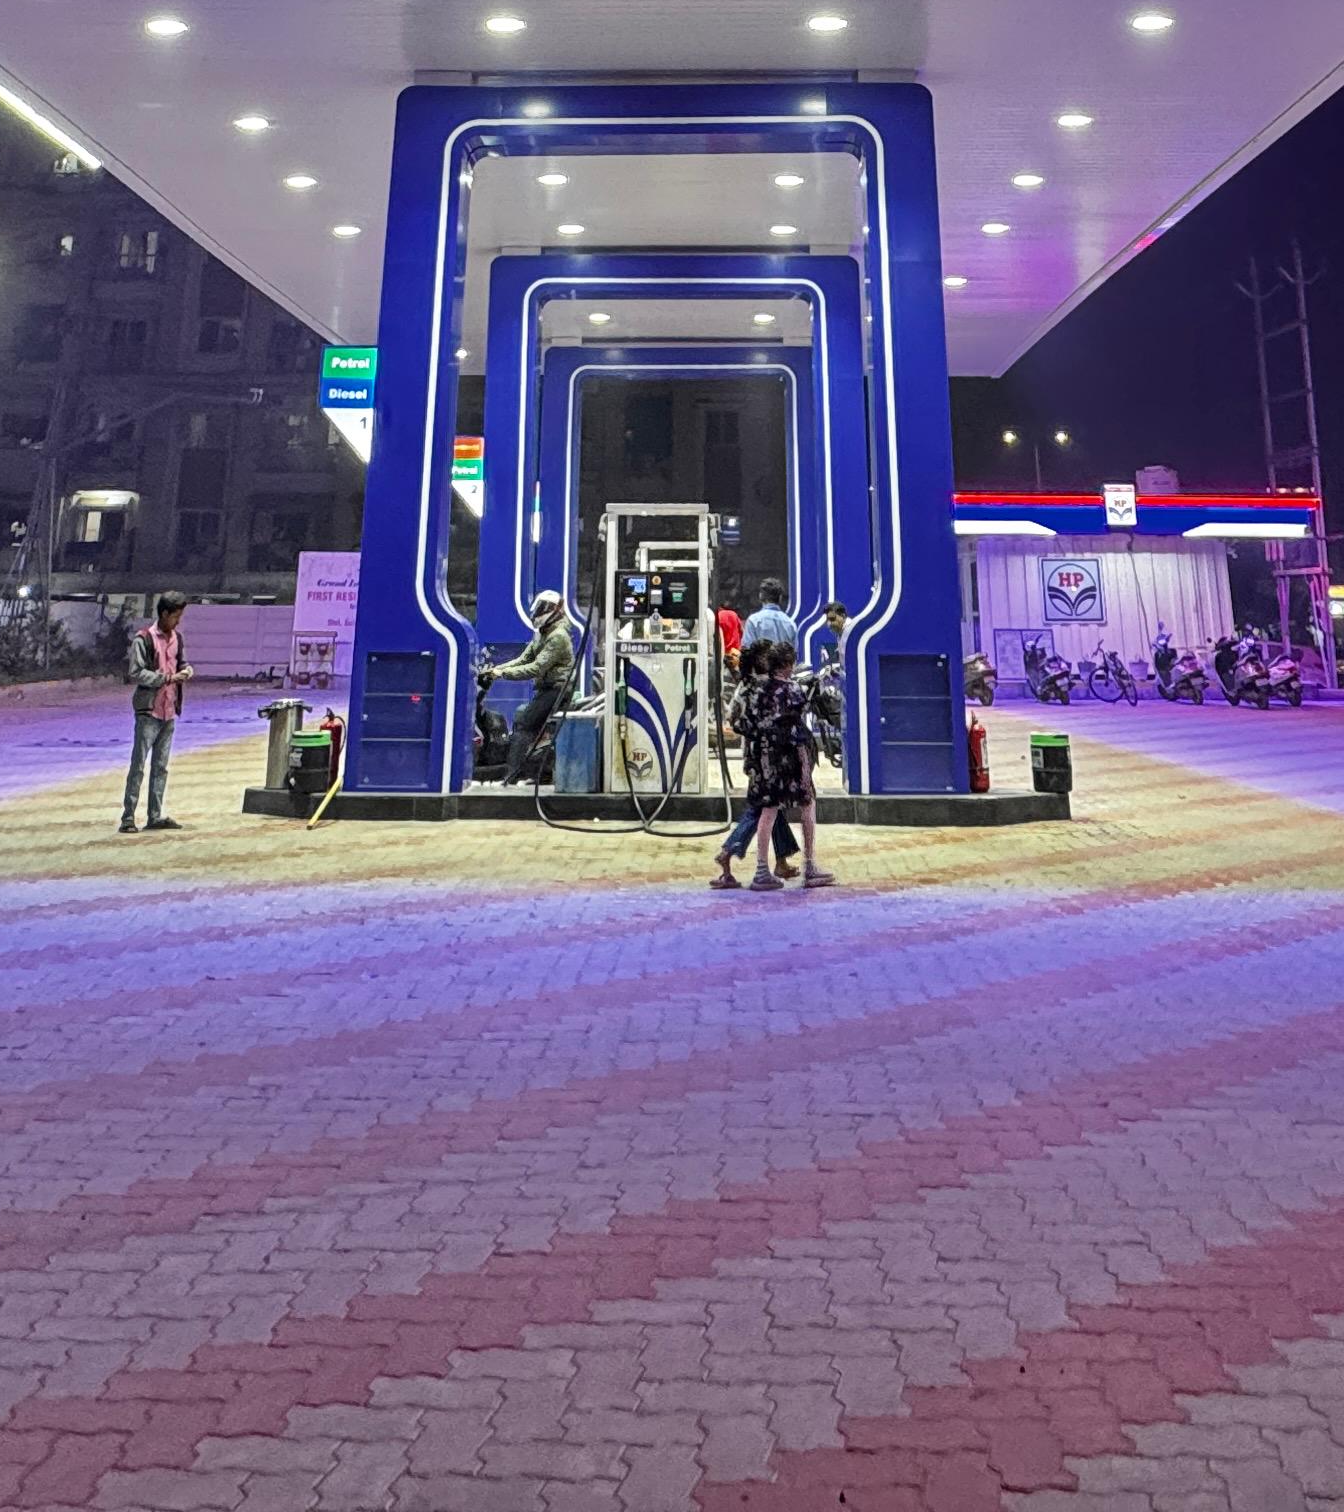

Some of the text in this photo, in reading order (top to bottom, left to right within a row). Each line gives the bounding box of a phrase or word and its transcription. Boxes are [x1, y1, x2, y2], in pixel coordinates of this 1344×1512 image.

[331, 357, 370, 369] Petrol
[328, 388, 368, 400] Diesel
[360, 417, 367, 429] 1
[471, 485, 478, 494] 2
[1058, 572, 1084, 588] HP
[307, 591, 333, 601] FIRST
[632, 752, 648, 761] HP
